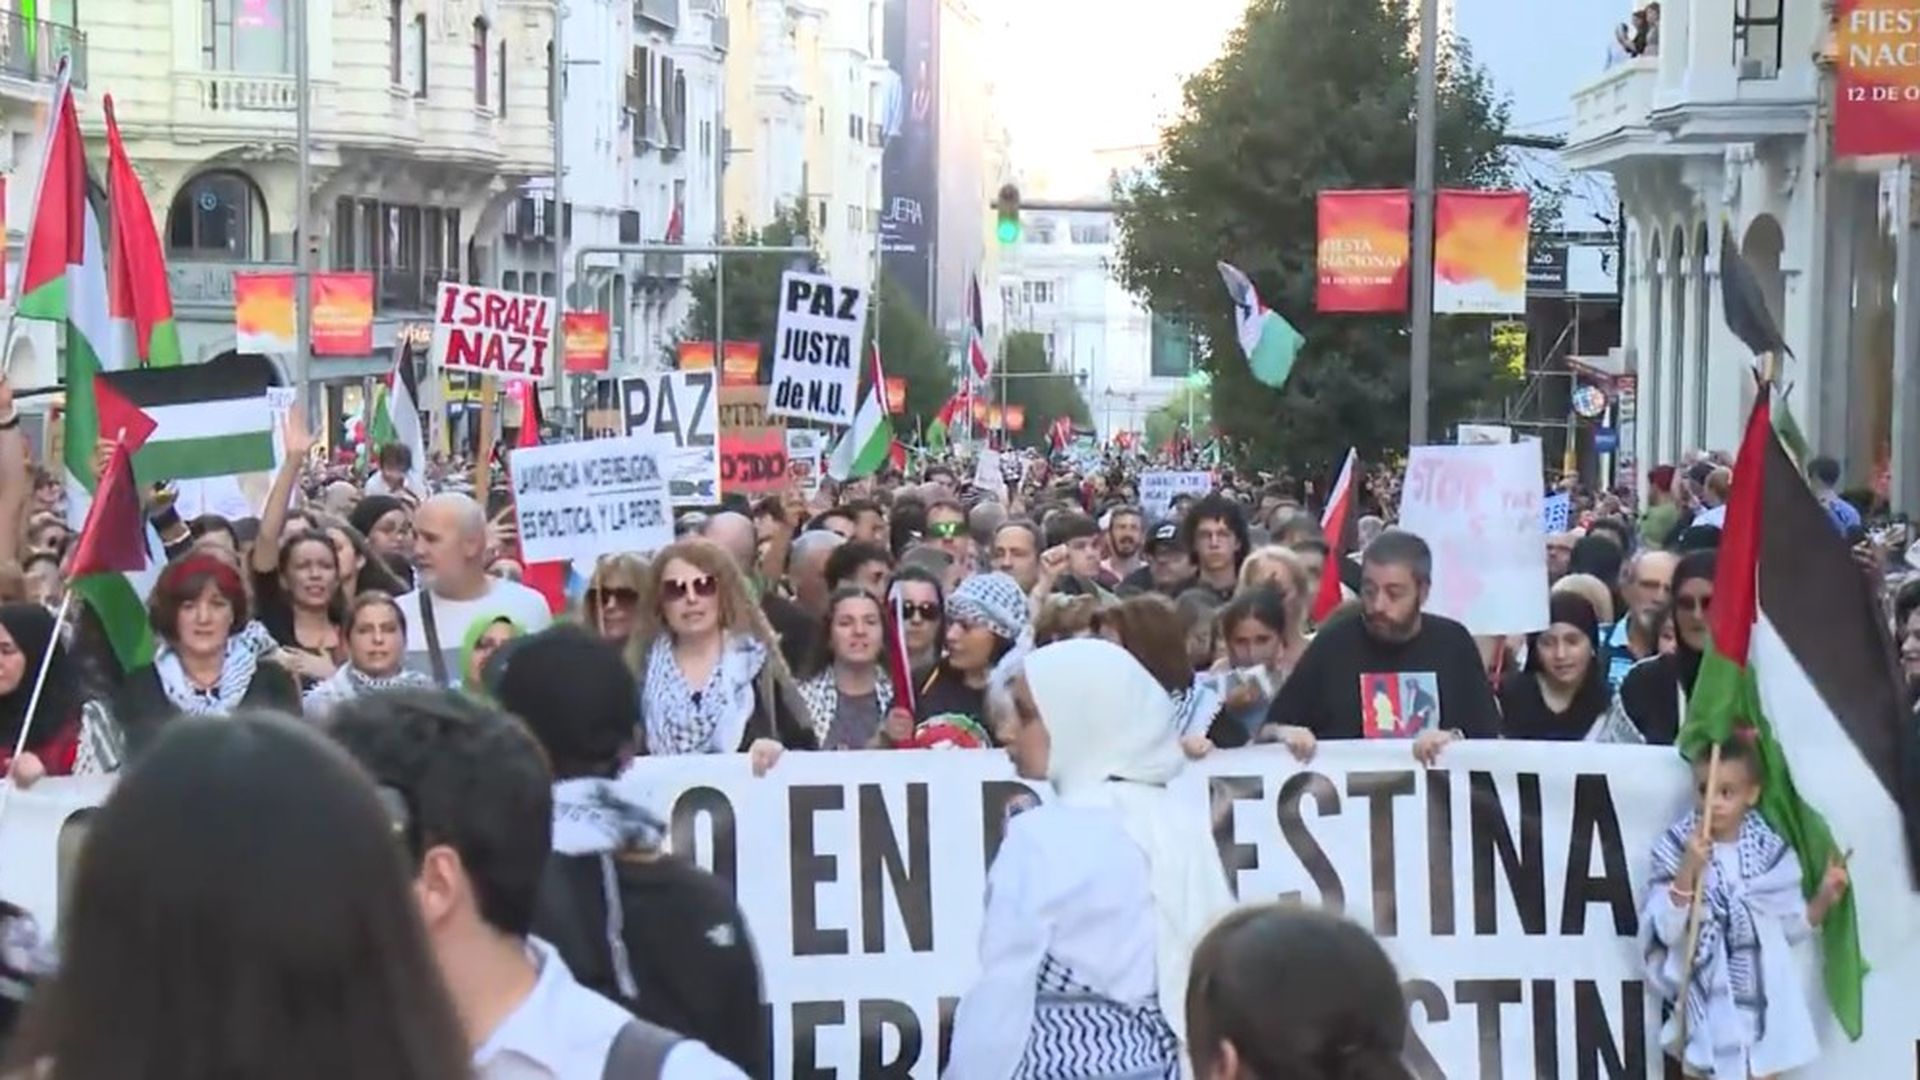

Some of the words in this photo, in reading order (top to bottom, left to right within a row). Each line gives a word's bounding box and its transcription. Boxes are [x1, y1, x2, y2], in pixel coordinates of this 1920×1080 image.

[1849, 42, 1920, 67] NAC
[1847, 86, 1865, 102] 12
[1872, 86, 1899, 101] DE
[1322, 239, 1372, 252] FIESTA
[441, 286, 549, 337] ISRAEL
[786, 279, 860, 321] PAZ
[445, 329, 548, 376] NAZI
[781, 327, 850, 368] JUSTA
[621, 372, 715, 447] PAZ
[775, 375, 804, 410] de
[807, 379, 846, 416] N.U.
[599, 504, 608, 534] Y
[611, 502, 626, 531] LA
[788, 782, 934, 956] EN
[982, 769, 1639, 936] ESTINA
